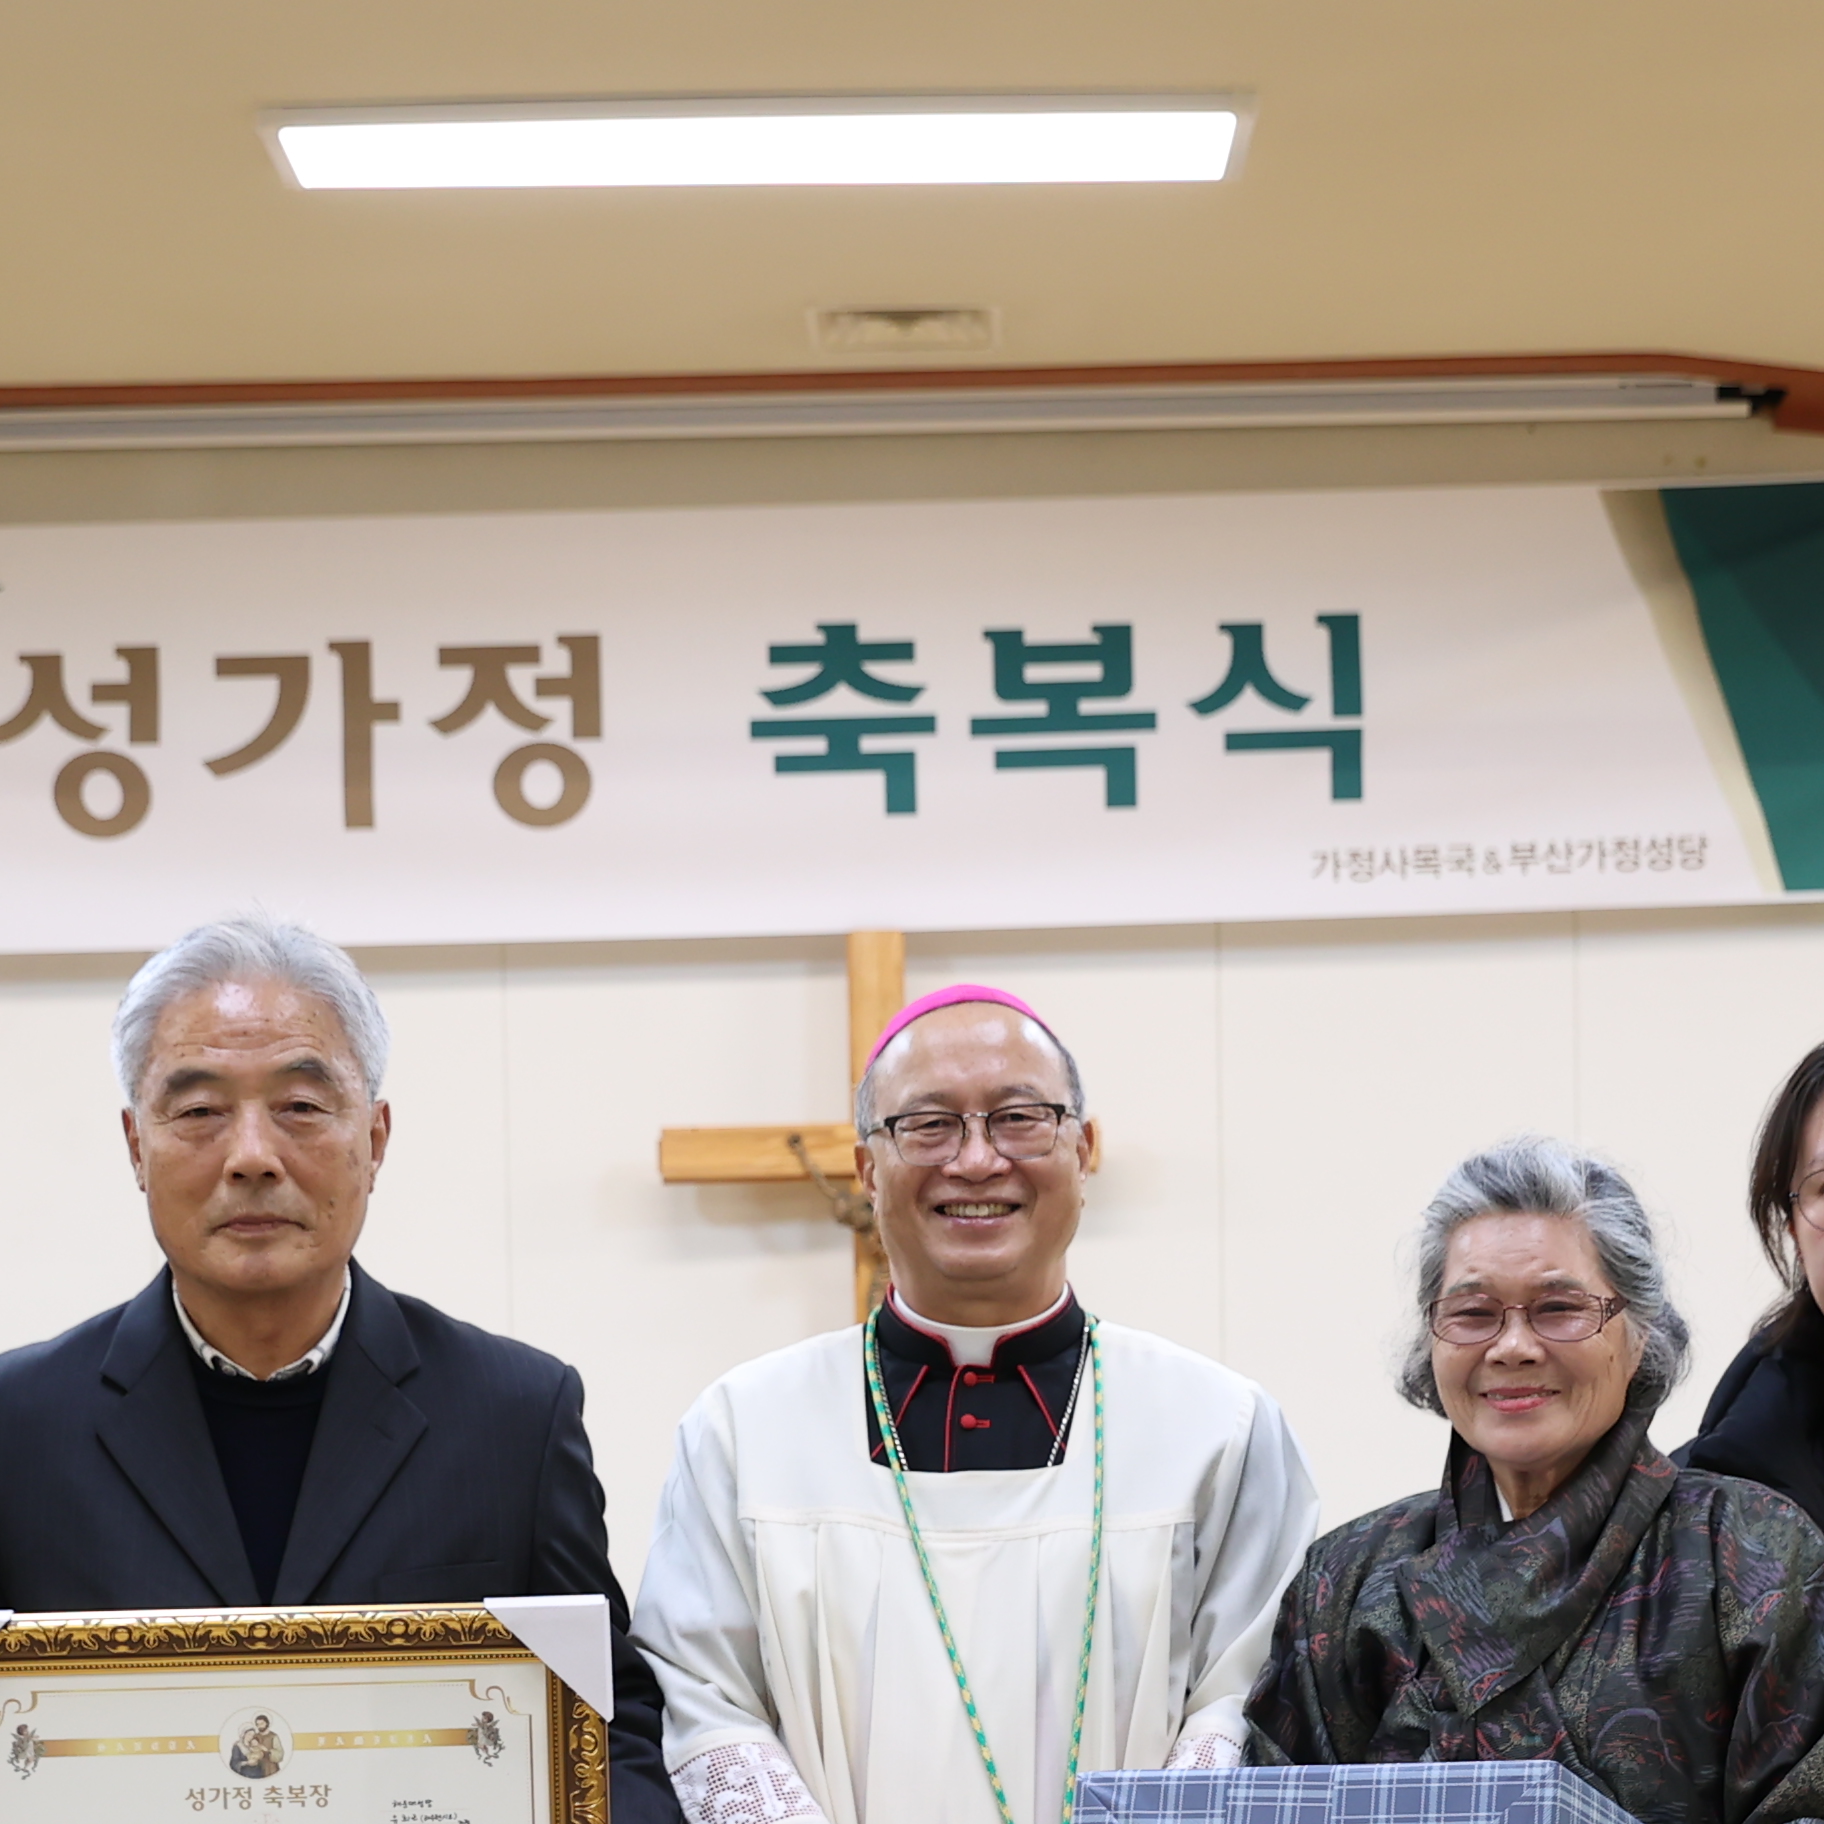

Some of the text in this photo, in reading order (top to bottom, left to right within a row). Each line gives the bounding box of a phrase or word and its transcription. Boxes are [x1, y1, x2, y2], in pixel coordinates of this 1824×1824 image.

[749, 612, 1366, 816] 축복식
[184, 1783, 333, 1812] 성가정 축복장
